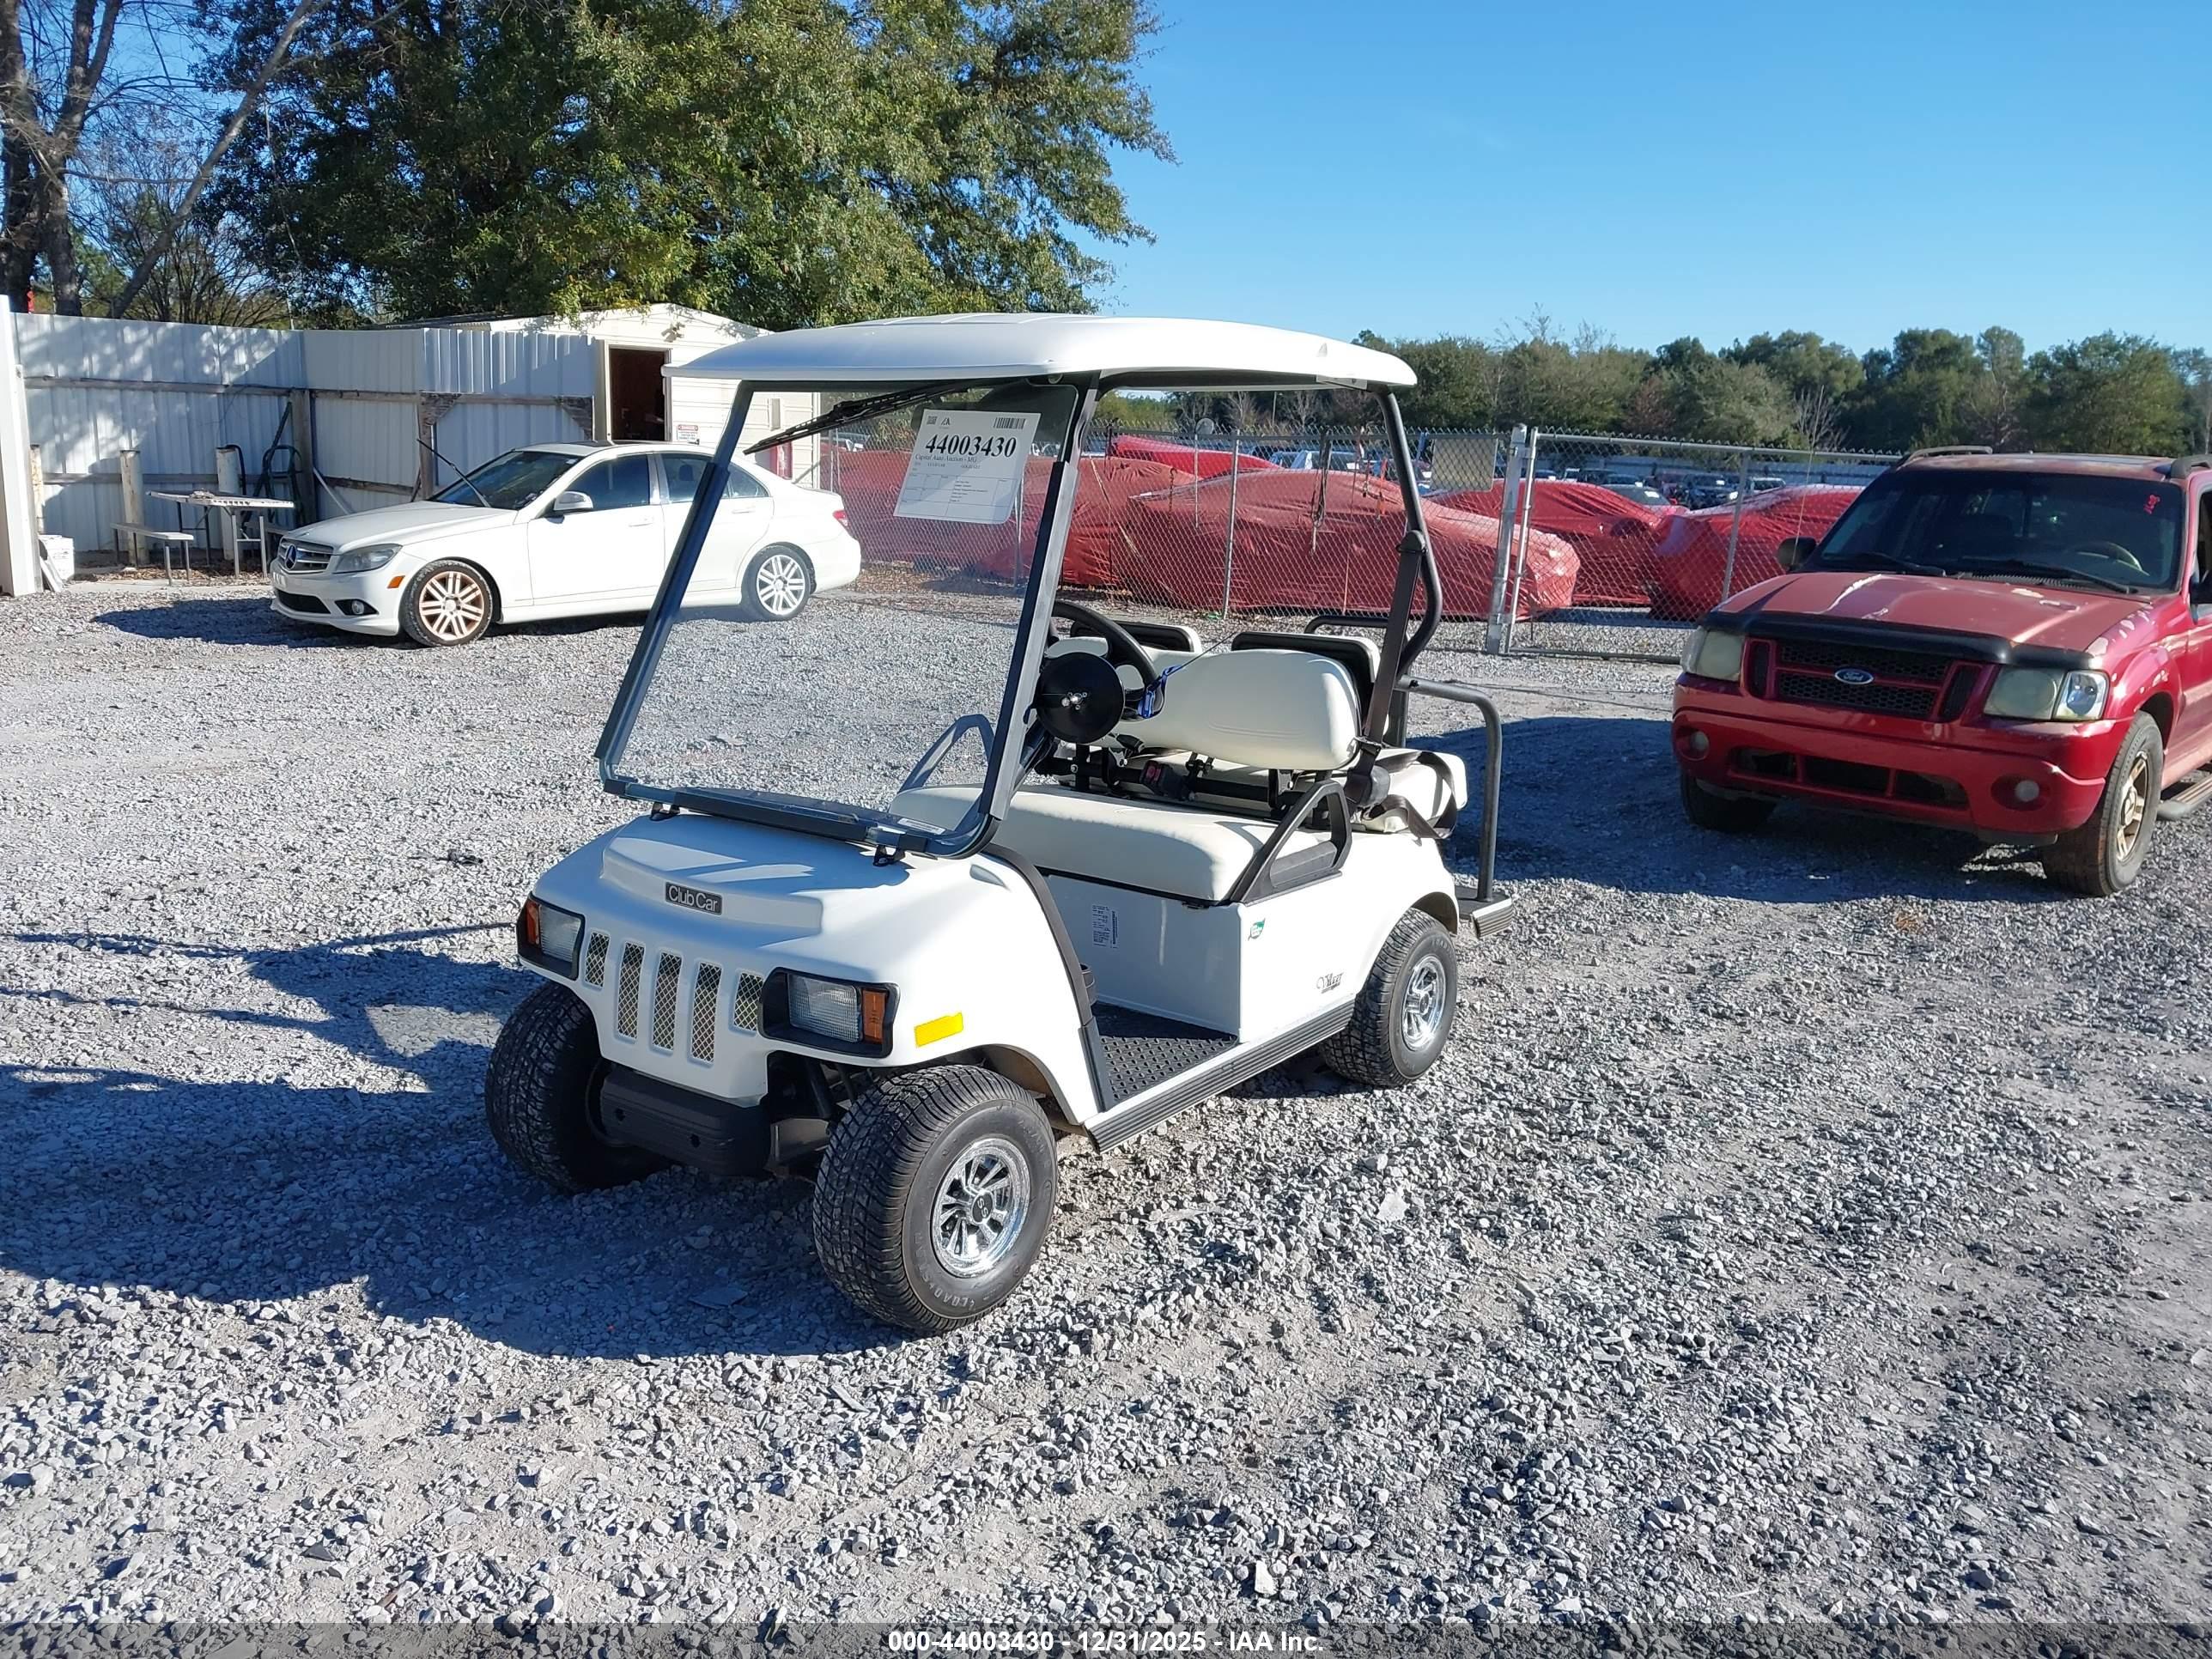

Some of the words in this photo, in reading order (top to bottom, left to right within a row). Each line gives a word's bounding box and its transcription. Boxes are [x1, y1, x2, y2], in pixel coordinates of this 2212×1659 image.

[925, 434, 1017, 457] 44003430
[668, 884, 695, 906] Club
[696, 892, 718, 911] Car
